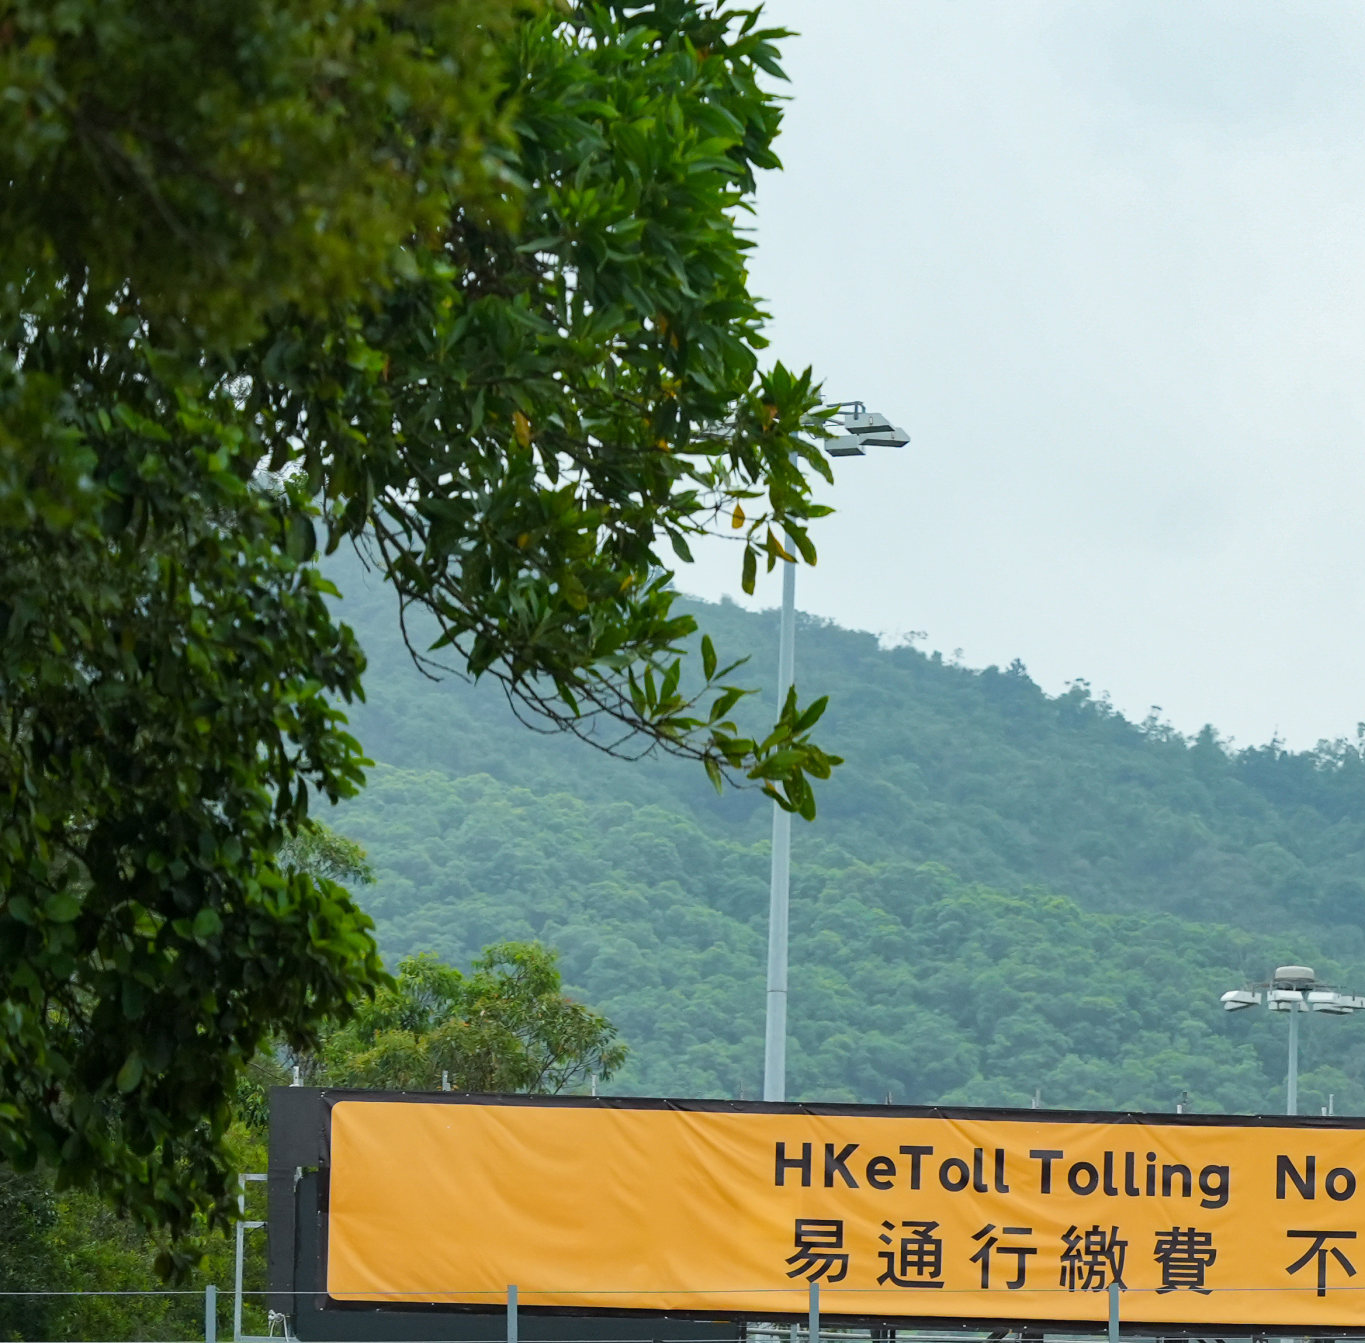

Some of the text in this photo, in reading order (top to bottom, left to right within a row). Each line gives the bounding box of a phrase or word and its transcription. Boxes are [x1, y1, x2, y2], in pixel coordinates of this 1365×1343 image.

[774, 1141, 1010, 1194] HKeToll
[1029, 1149, 1230, 1209] Tolling
[1275, 1154, 1357, 1202] No
[784, 1218, 1218, 1296] 易通行繳費
